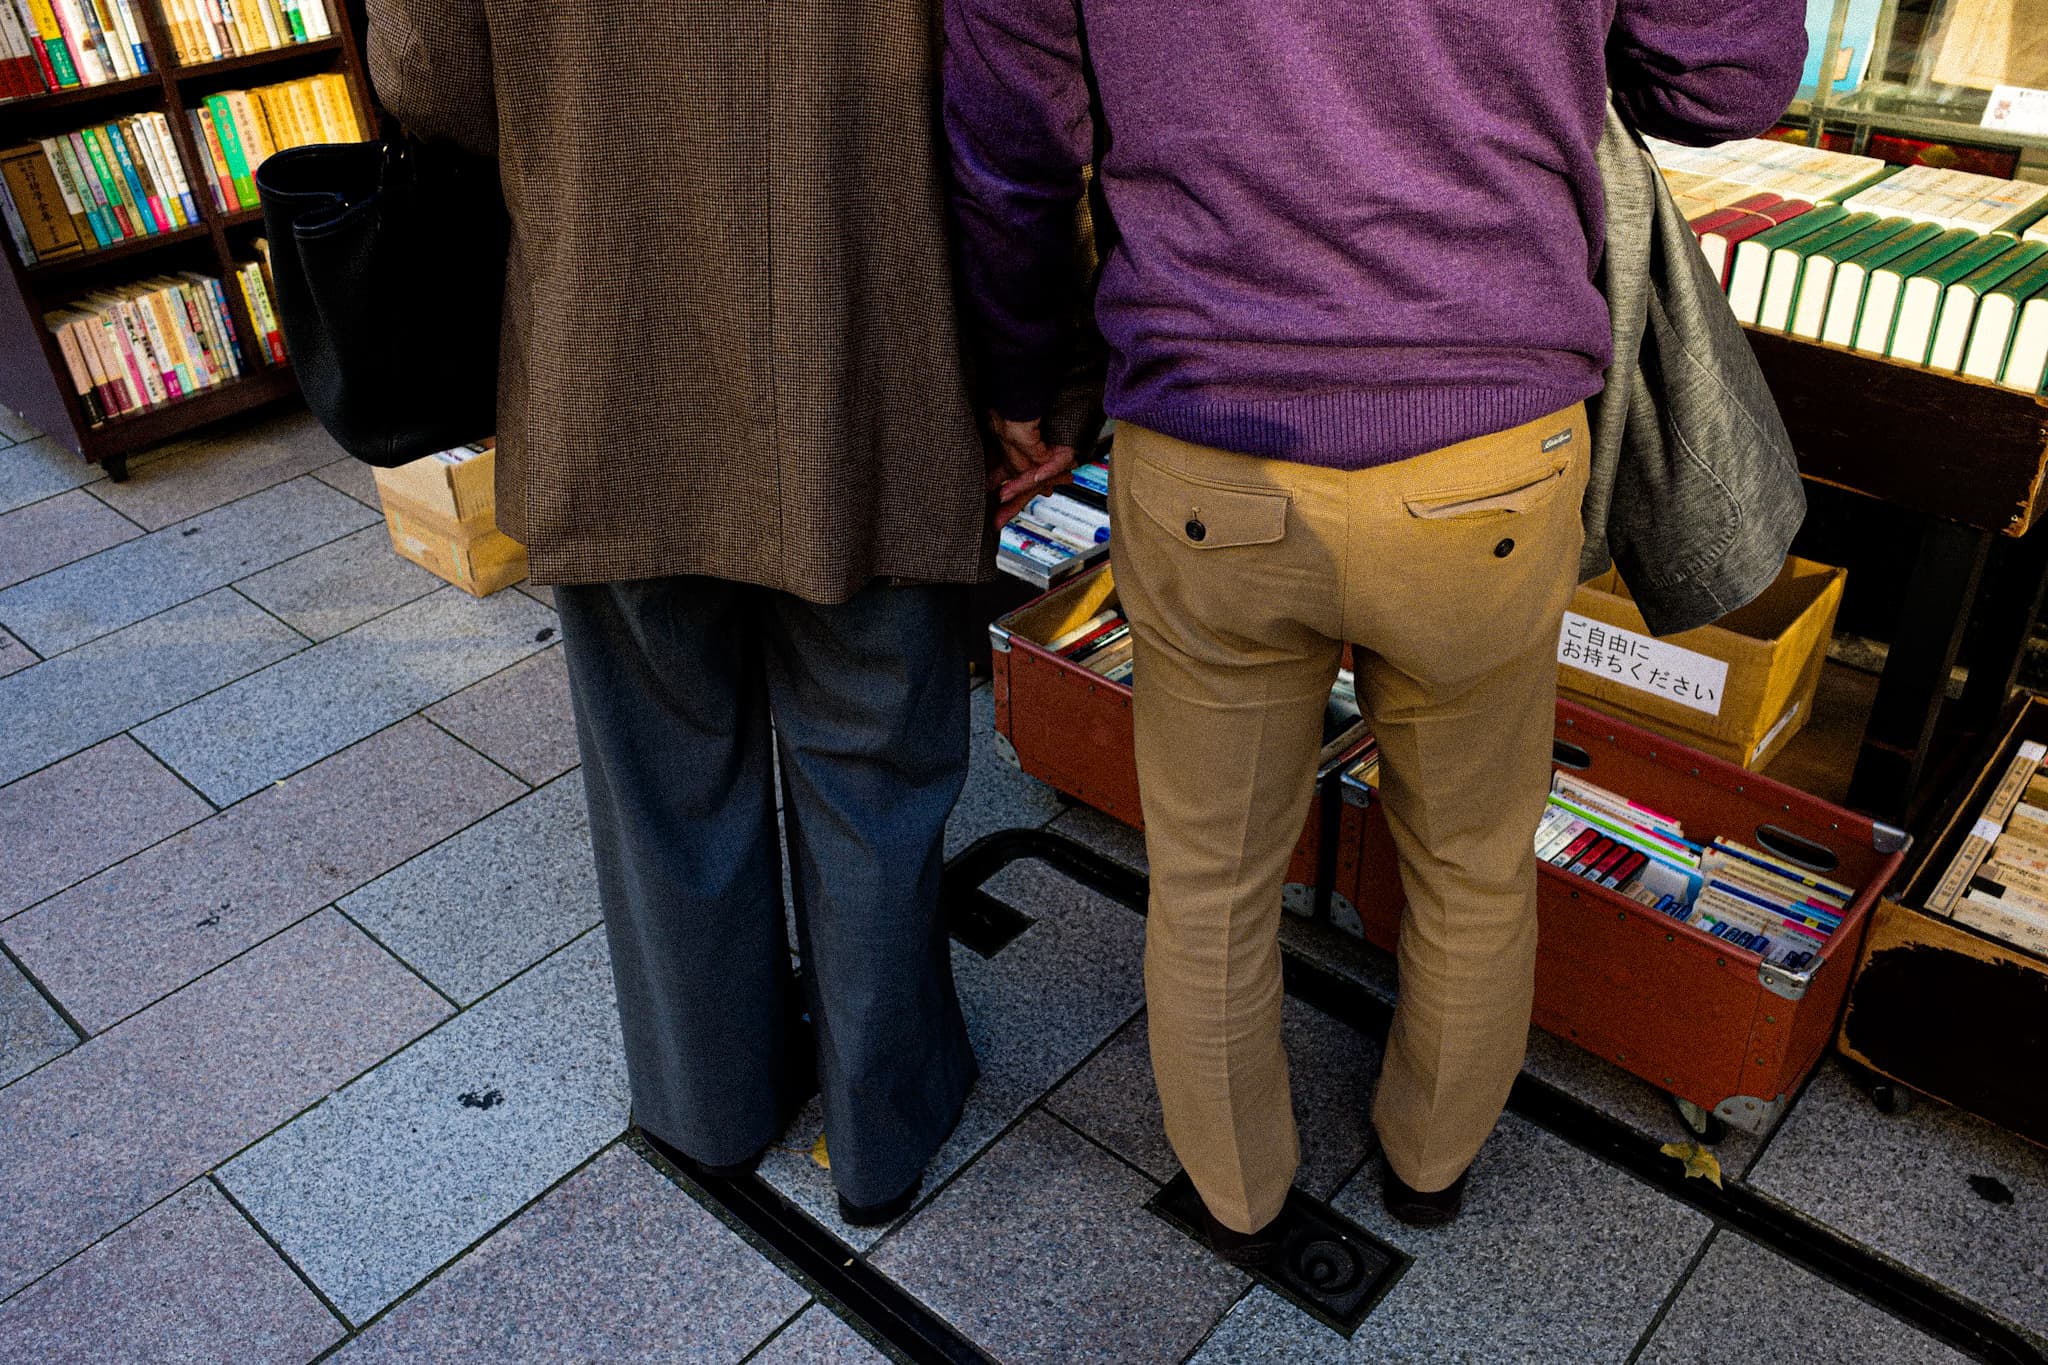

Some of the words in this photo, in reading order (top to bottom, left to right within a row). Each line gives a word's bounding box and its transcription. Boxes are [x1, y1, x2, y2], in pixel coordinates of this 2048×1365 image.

[1567, 621, 1650, 660] ご自由に
[1562, 639, 1715, 701] お持ちください
